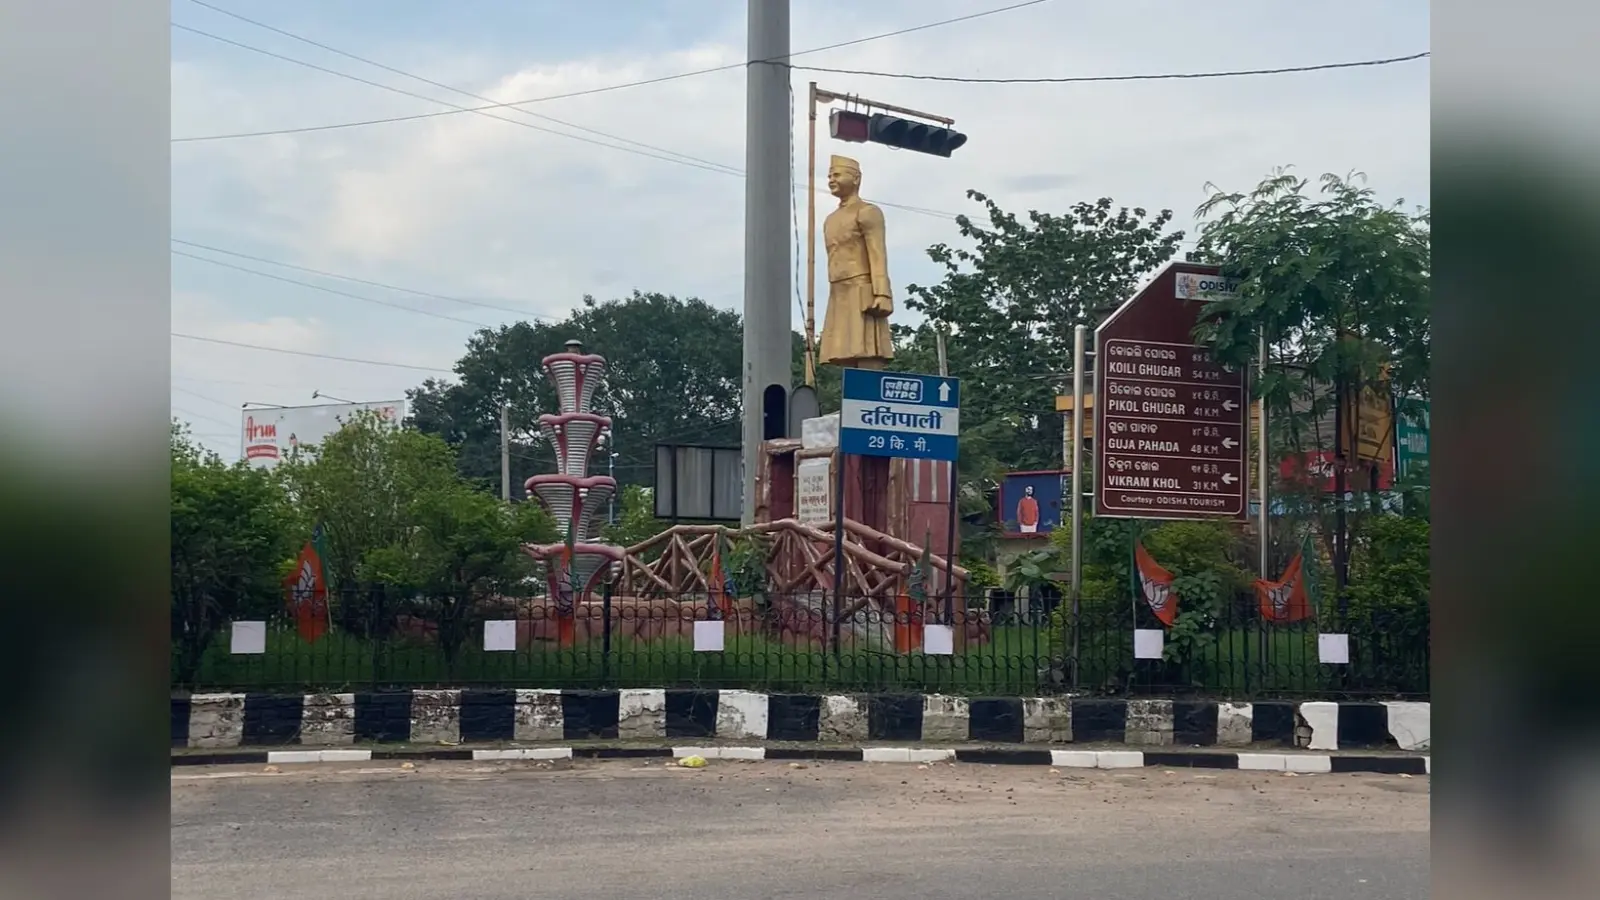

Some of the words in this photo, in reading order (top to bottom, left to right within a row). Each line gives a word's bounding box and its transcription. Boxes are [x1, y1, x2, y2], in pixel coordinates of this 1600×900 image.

[1109, 362, 1136, 374] KOILI
[1138, 364, 1182, 377] GHUGAR
[1192, 370, 1203, 379] 54
[884, 390, 917, 399] NTPC
[1108, 400, 1139, 412] PIKOL
[1142, 401, 1186, 415] GHUGAR
[1193, 407, 1203, 417] 41
[868, 435, 885, 448] 29
[1108, 438, 1136, 450] GUJA
[1138, 440, 1180, 453] PAHADA
[1190, 444, 1202, 454] 48
[1108, 475, 1150, 487] VIKRAM
[1152, 478, 1181, 489] KHOL
[1192, 481, 1202, 490] 31
[1156, 496, 1188, 505] ODISHA
[1189, 497, 1225, 507] TOURISM
